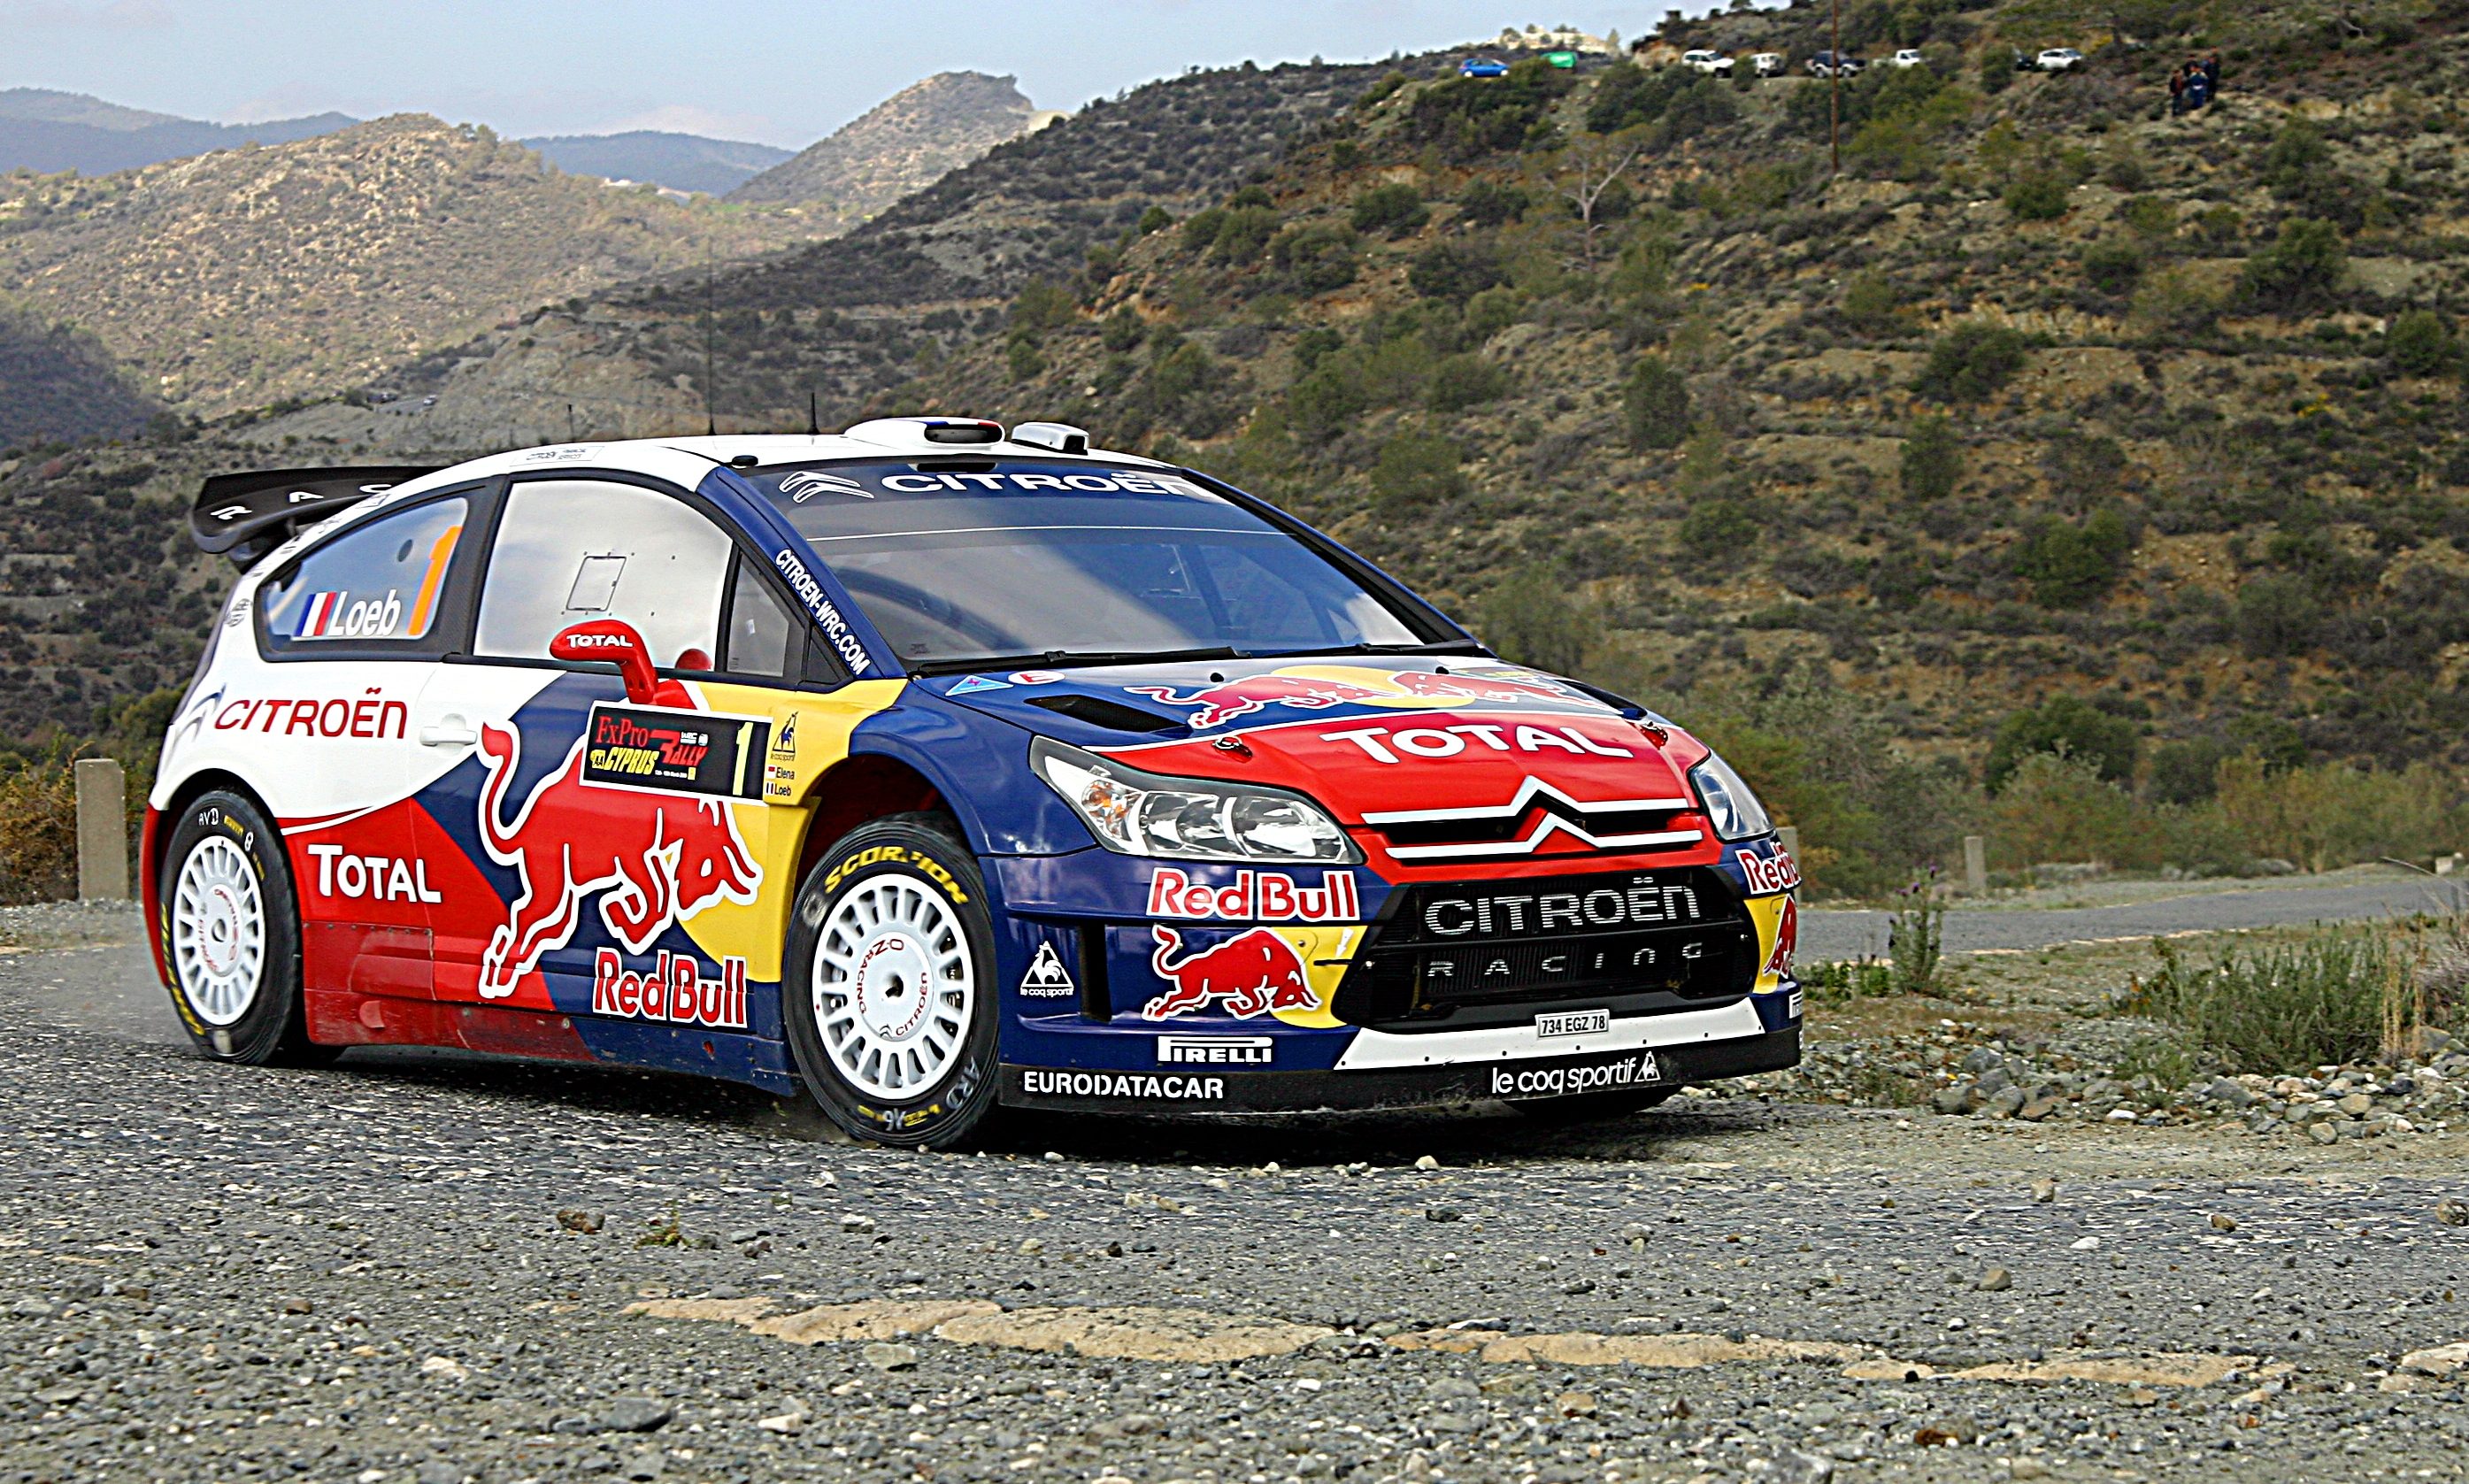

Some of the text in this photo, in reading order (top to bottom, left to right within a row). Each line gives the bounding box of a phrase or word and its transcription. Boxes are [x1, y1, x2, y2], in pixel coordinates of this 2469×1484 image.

[408, 526, 464, 635] 1
[327, 588, 402, 636] Loeb
[775, 549, 871, 675] CITROEN-WRC.COM
[565, 634, 634, 648] TOTAL
[214, 687, 408, 740] CITROËN
[596, 715, 650, 748] FxPro
[604, 746, 660, 775] CYPRUS
[732, 721, 754, 796] 1
[1319, 724, 1634, 764] TOTAL
[774, 783, 792, 796] Loeb
[776, 766, 795, 780] Elena
[307, 843, 442, 903] TOTAL
[1148, 868, 1360, 921] Red Bull
[1425, 876, 1702, 935] CITROËN
[594, 950, 746, 1026] Red Bull
[1028, 988, 1046, 997] coq
[1542, 1015, 1605, 1034] 734 EGZ 78
[1158, 1036, 1272, 1063] PIRELLI
[1023, 1071, 1224, 1100] EURODATACAR
[1492, 1057, 1637, 1094] le coq sportif
